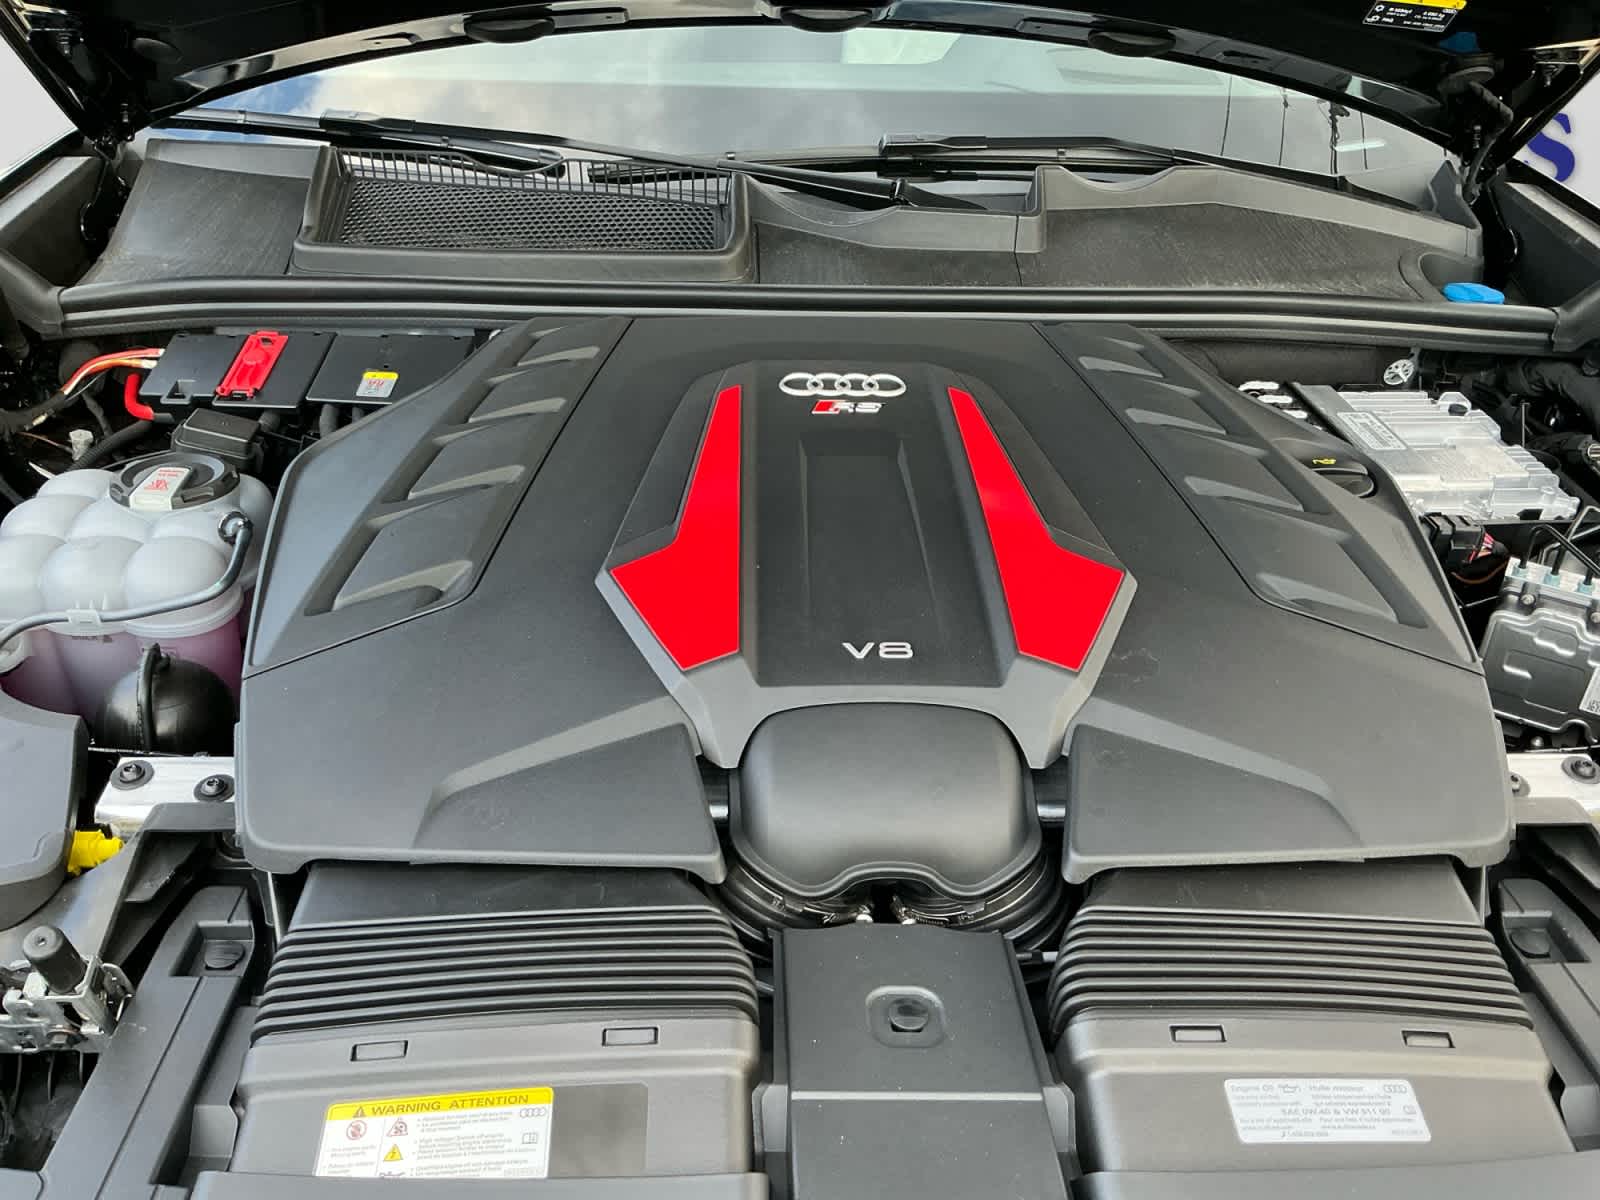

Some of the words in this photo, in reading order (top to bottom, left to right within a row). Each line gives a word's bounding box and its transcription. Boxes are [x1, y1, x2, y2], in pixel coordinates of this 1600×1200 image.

[811, 399, 886, 414] RS
[841, 641, 914, 659] V8
[371, 1100, 441, 1116] WARNING
[449, 1094, 529, 1111] ATTENTION
